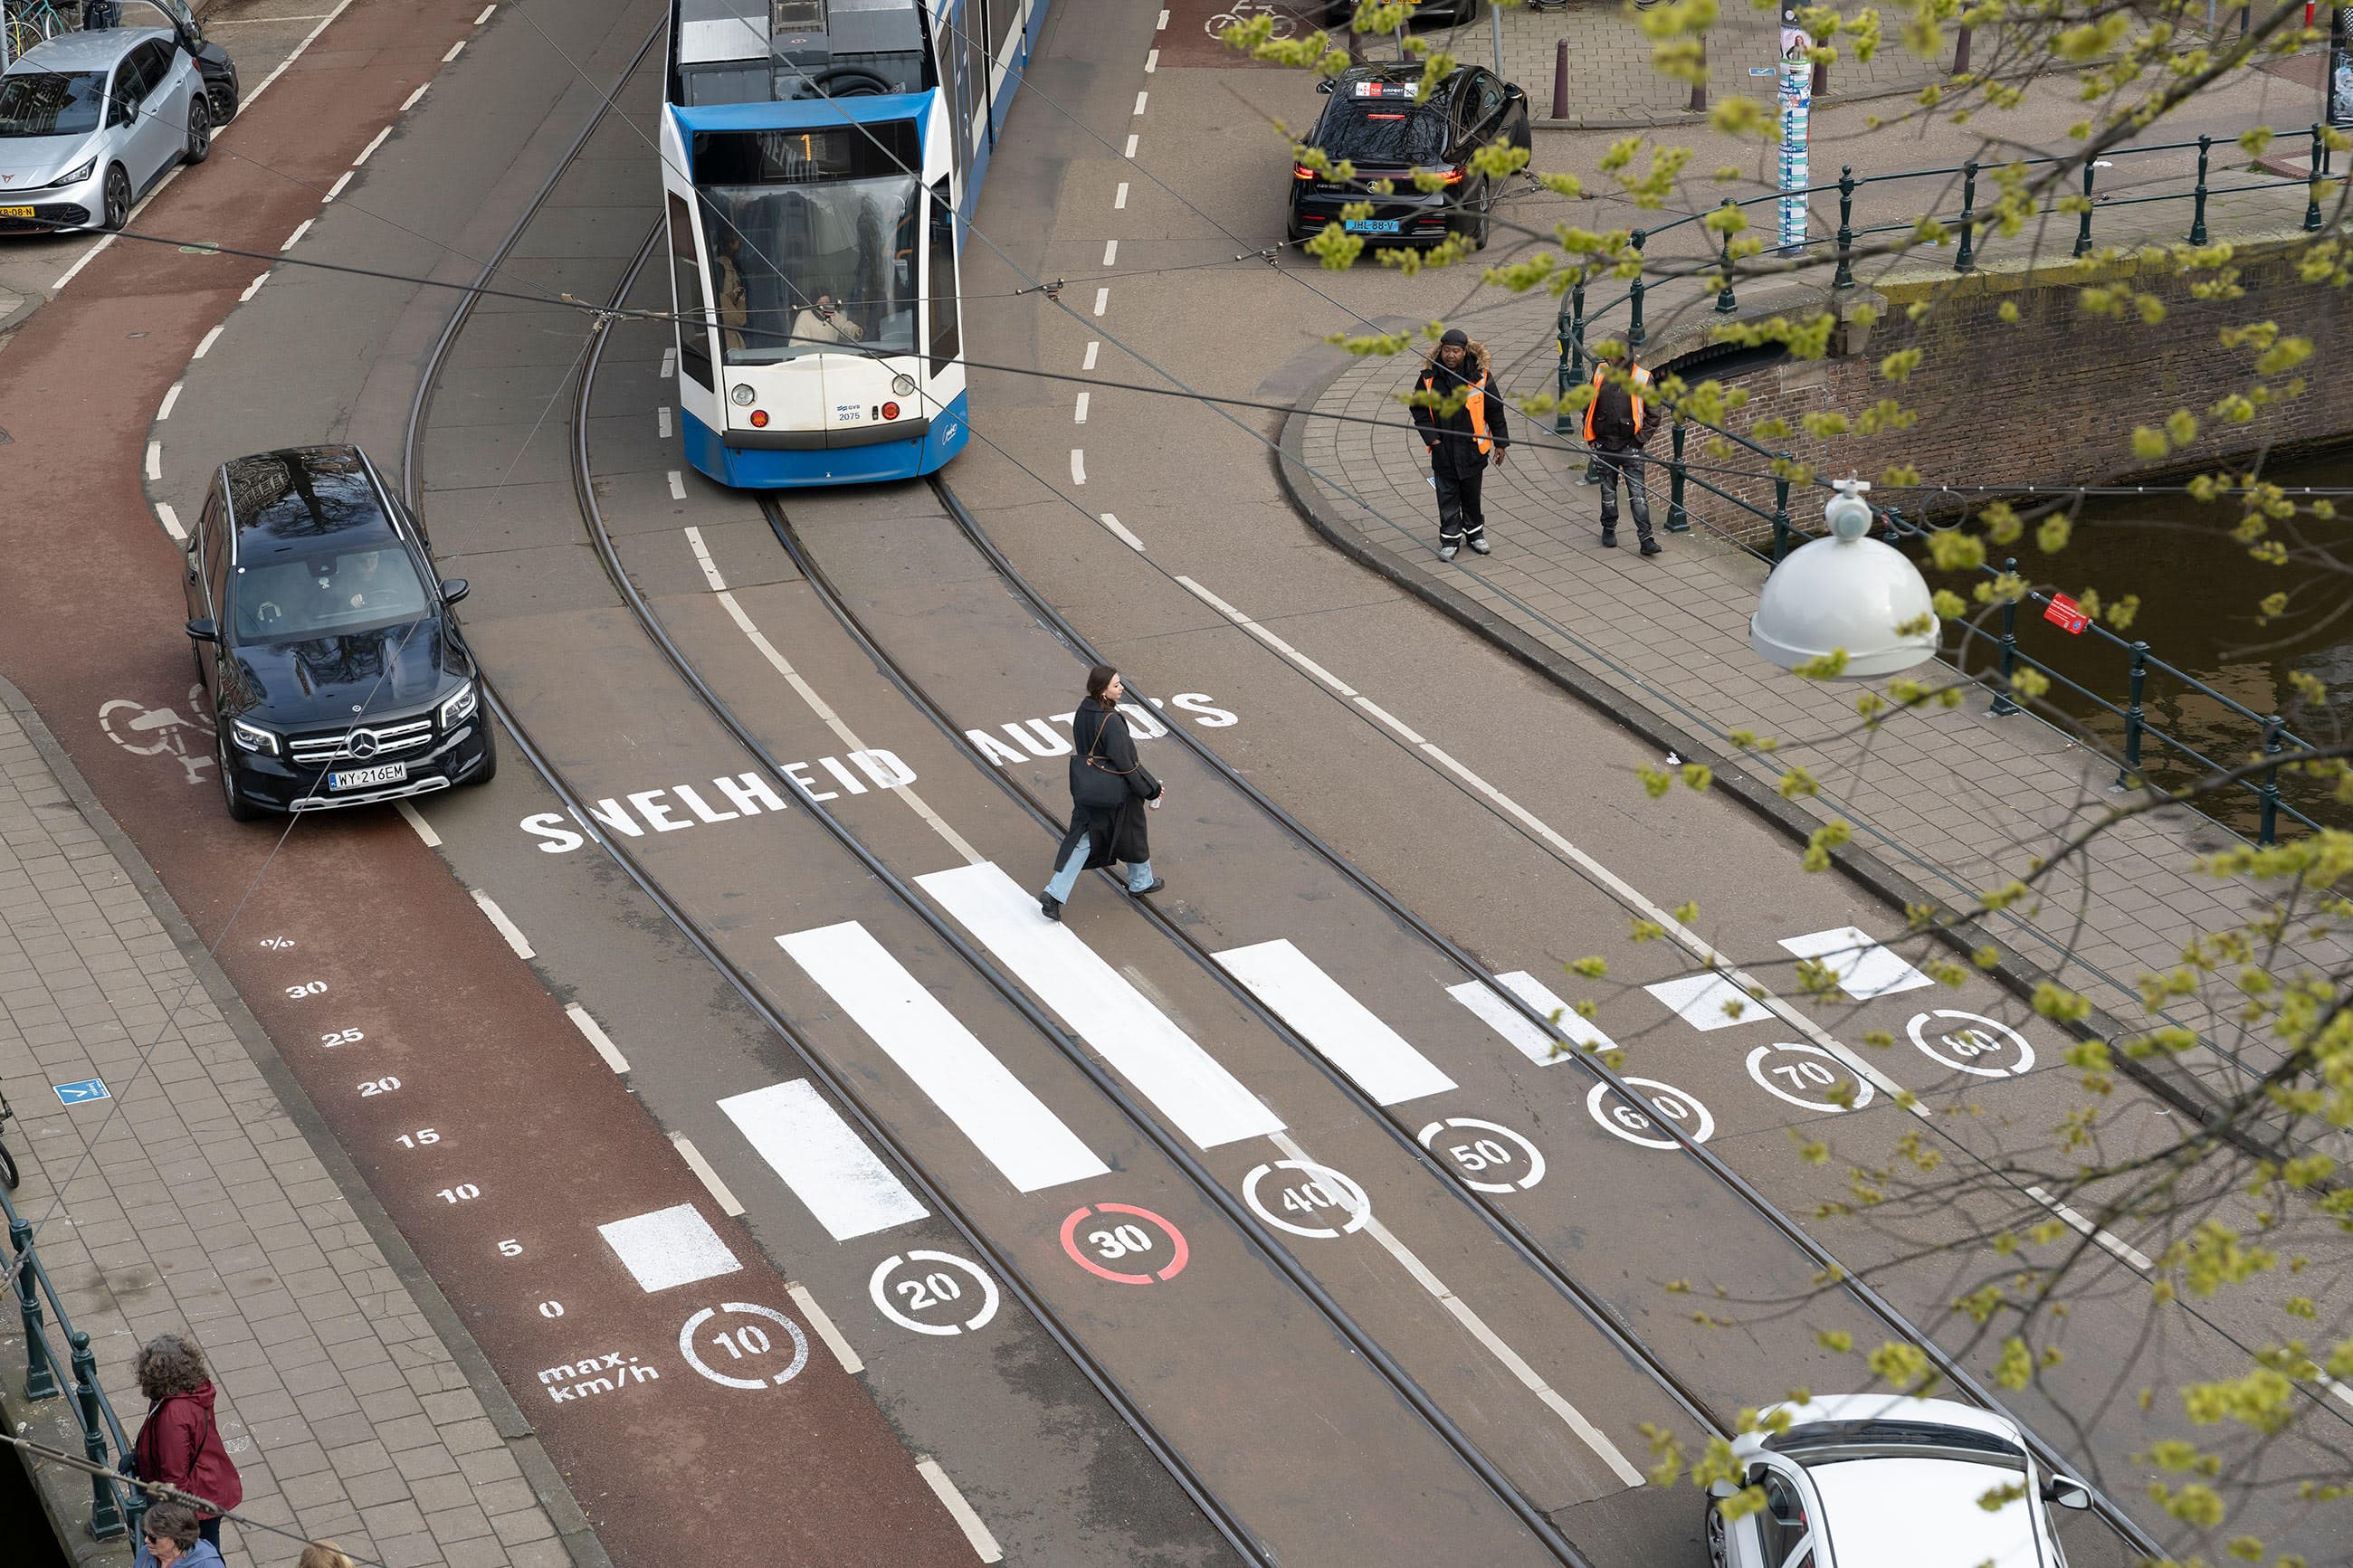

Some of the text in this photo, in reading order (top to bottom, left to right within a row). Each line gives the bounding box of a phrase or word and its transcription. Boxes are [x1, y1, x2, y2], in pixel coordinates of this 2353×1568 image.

[800, 133, 812, 162] 1
[839, 413, 860, 421] 2075
[338, 765, 404, 785] WY 216EM
[519, 748, 917, 853] SNELHEID
[260, 936, 296, 950] %
[285, 980, 328, 999] 30
[321, 1027, 364, 1048] 25
[1941, 1029, 2002, 1057] 80
[357, 1076, 402, 1098] 20
[1772, 1060, 1835, 1090] 70
[1613, 1095, 1689, 1130] 60
[395, 1127, 441, 1149] 15
[1449, 1139, 1512, 1171] 50
[435, 1183, 481, 1204] 10
[1282, 1182, 1338, 1213] 40
[497, 1238, 523, 1257] 5
[1088, 1223, 1153, 1259] 30
[896, 1272, 961, 1311] 20
[538, 1300, 565, 1319] 0
[712, 1325, 771, 1360] 10
[537, 1351, 639, 1385] max.
[547, 1364, 660, 1404] km/h
